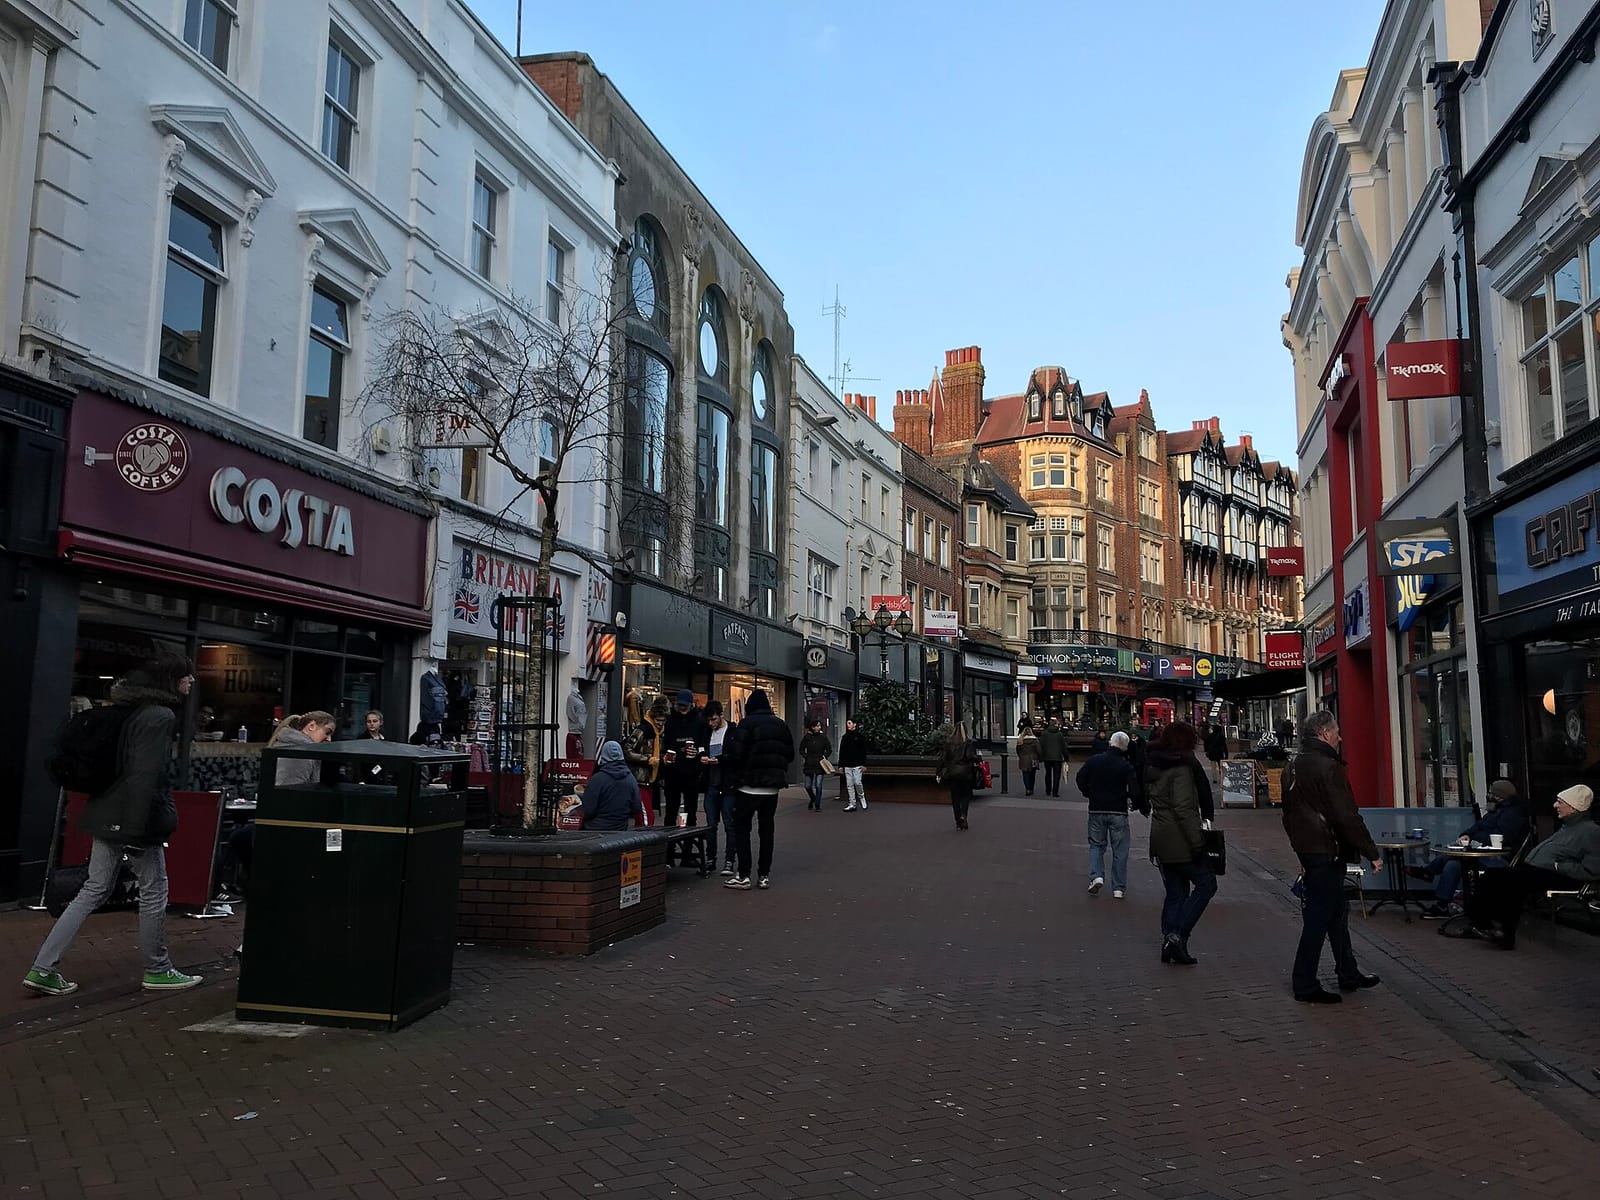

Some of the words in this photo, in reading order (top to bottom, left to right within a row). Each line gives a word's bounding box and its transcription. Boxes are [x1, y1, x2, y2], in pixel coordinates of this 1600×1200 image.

[126, 426, 176, 446] COSTA
[122, 463, 181, 488] COFFEE
[209, 466, 355, 557] COSTA
[1556, 606, 1574, 622] THE
[722, 622, 750, 646] FATFACE
[1269, 652, 1300, 660] FLIGHT
[1159, 658, 1170, 675] P
